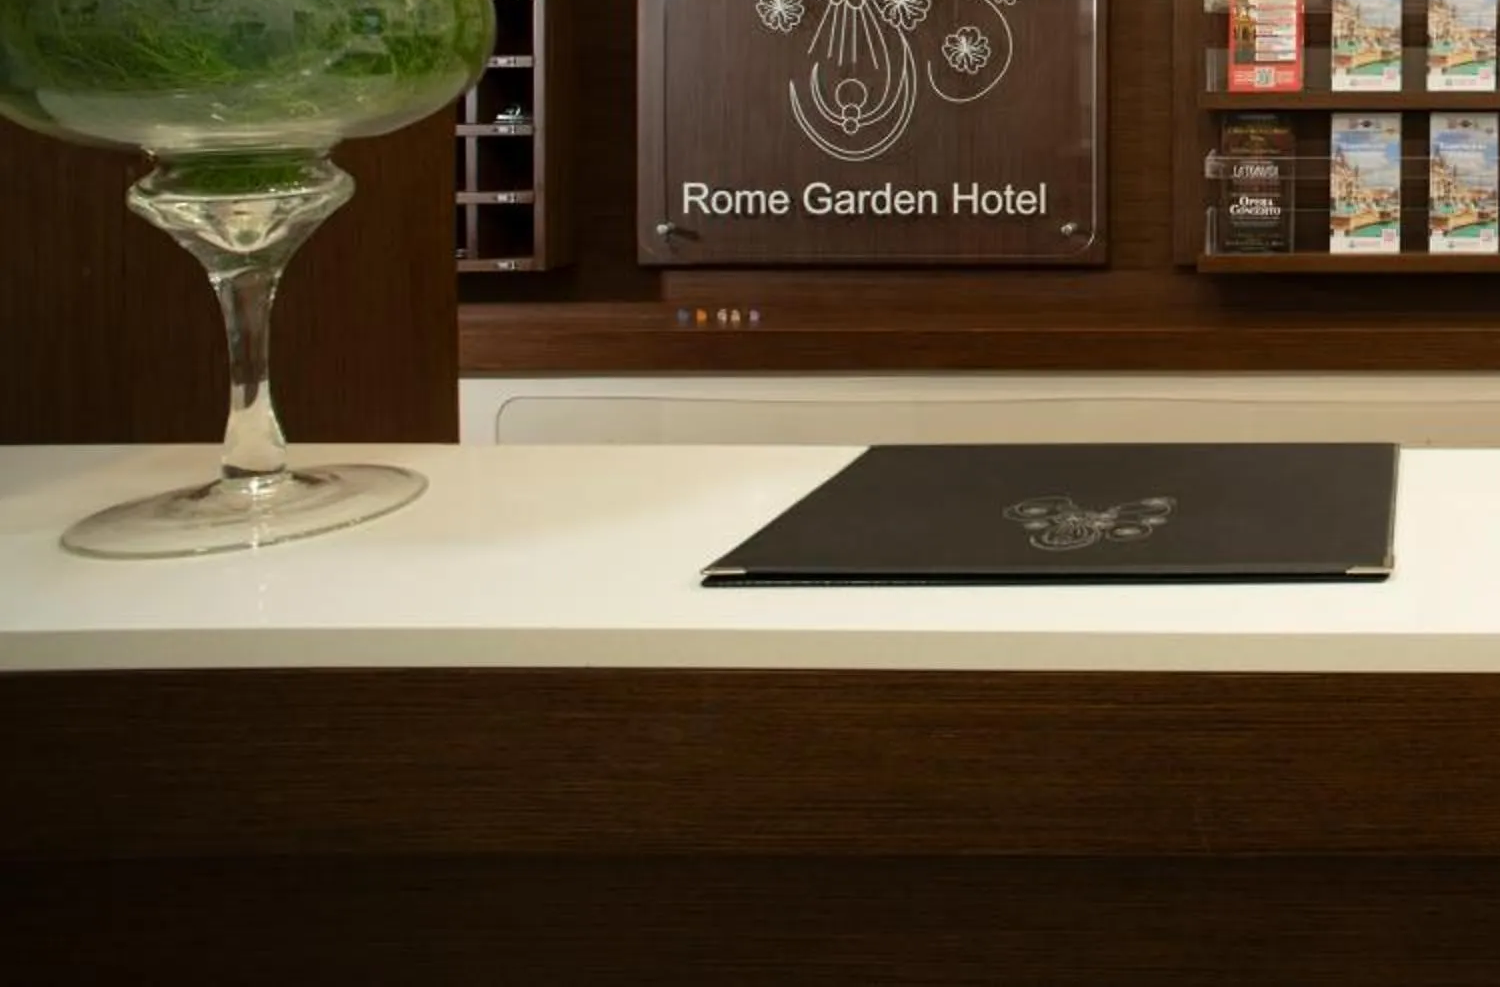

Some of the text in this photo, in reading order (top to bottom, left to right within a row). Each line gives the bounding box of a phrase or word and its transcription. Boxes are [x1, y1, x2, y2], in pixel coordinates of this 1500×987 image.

[683, 182, 1047, 215] Rome Garden Hotel
